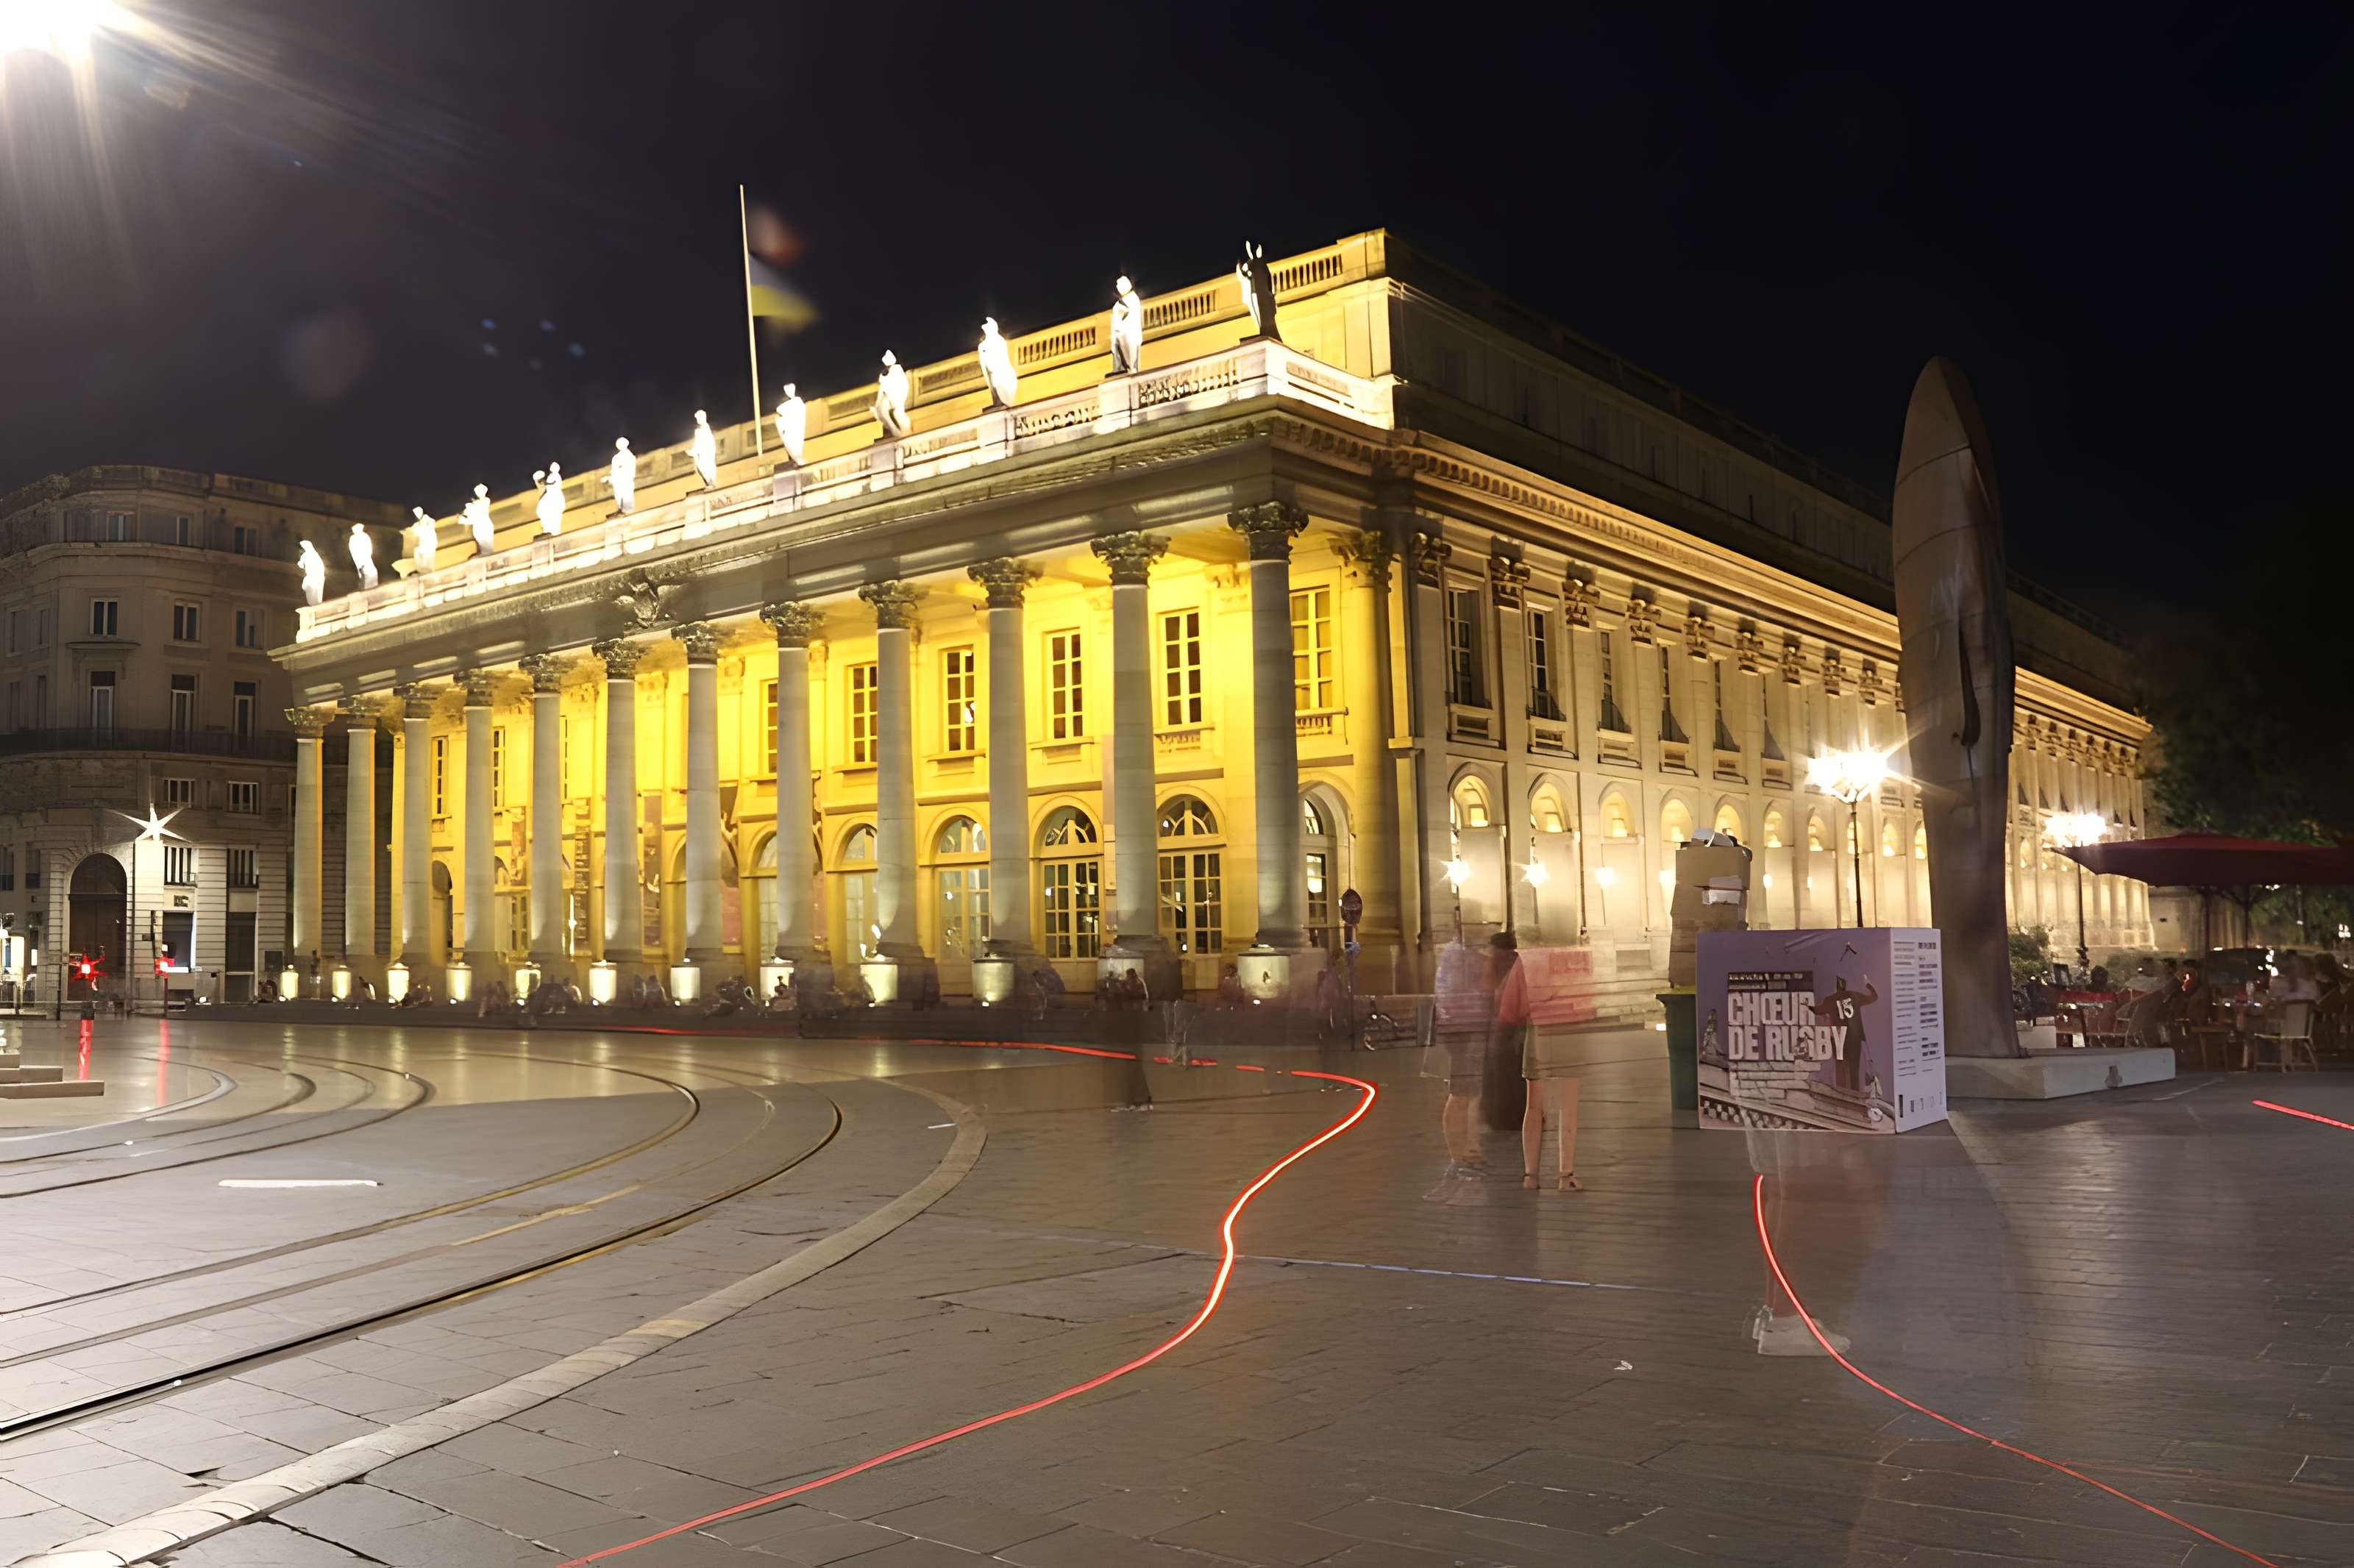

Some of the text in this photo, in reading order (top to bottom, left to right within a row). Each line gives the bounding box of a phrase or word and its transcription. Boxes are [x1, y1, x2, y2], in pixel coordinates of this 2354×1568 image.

[1729, 991, 1815, 1026] CHŒUR
[1836, 997, 1854, 1019] 15
[1729, 1026, 1847, 1060] DE RUGBY
